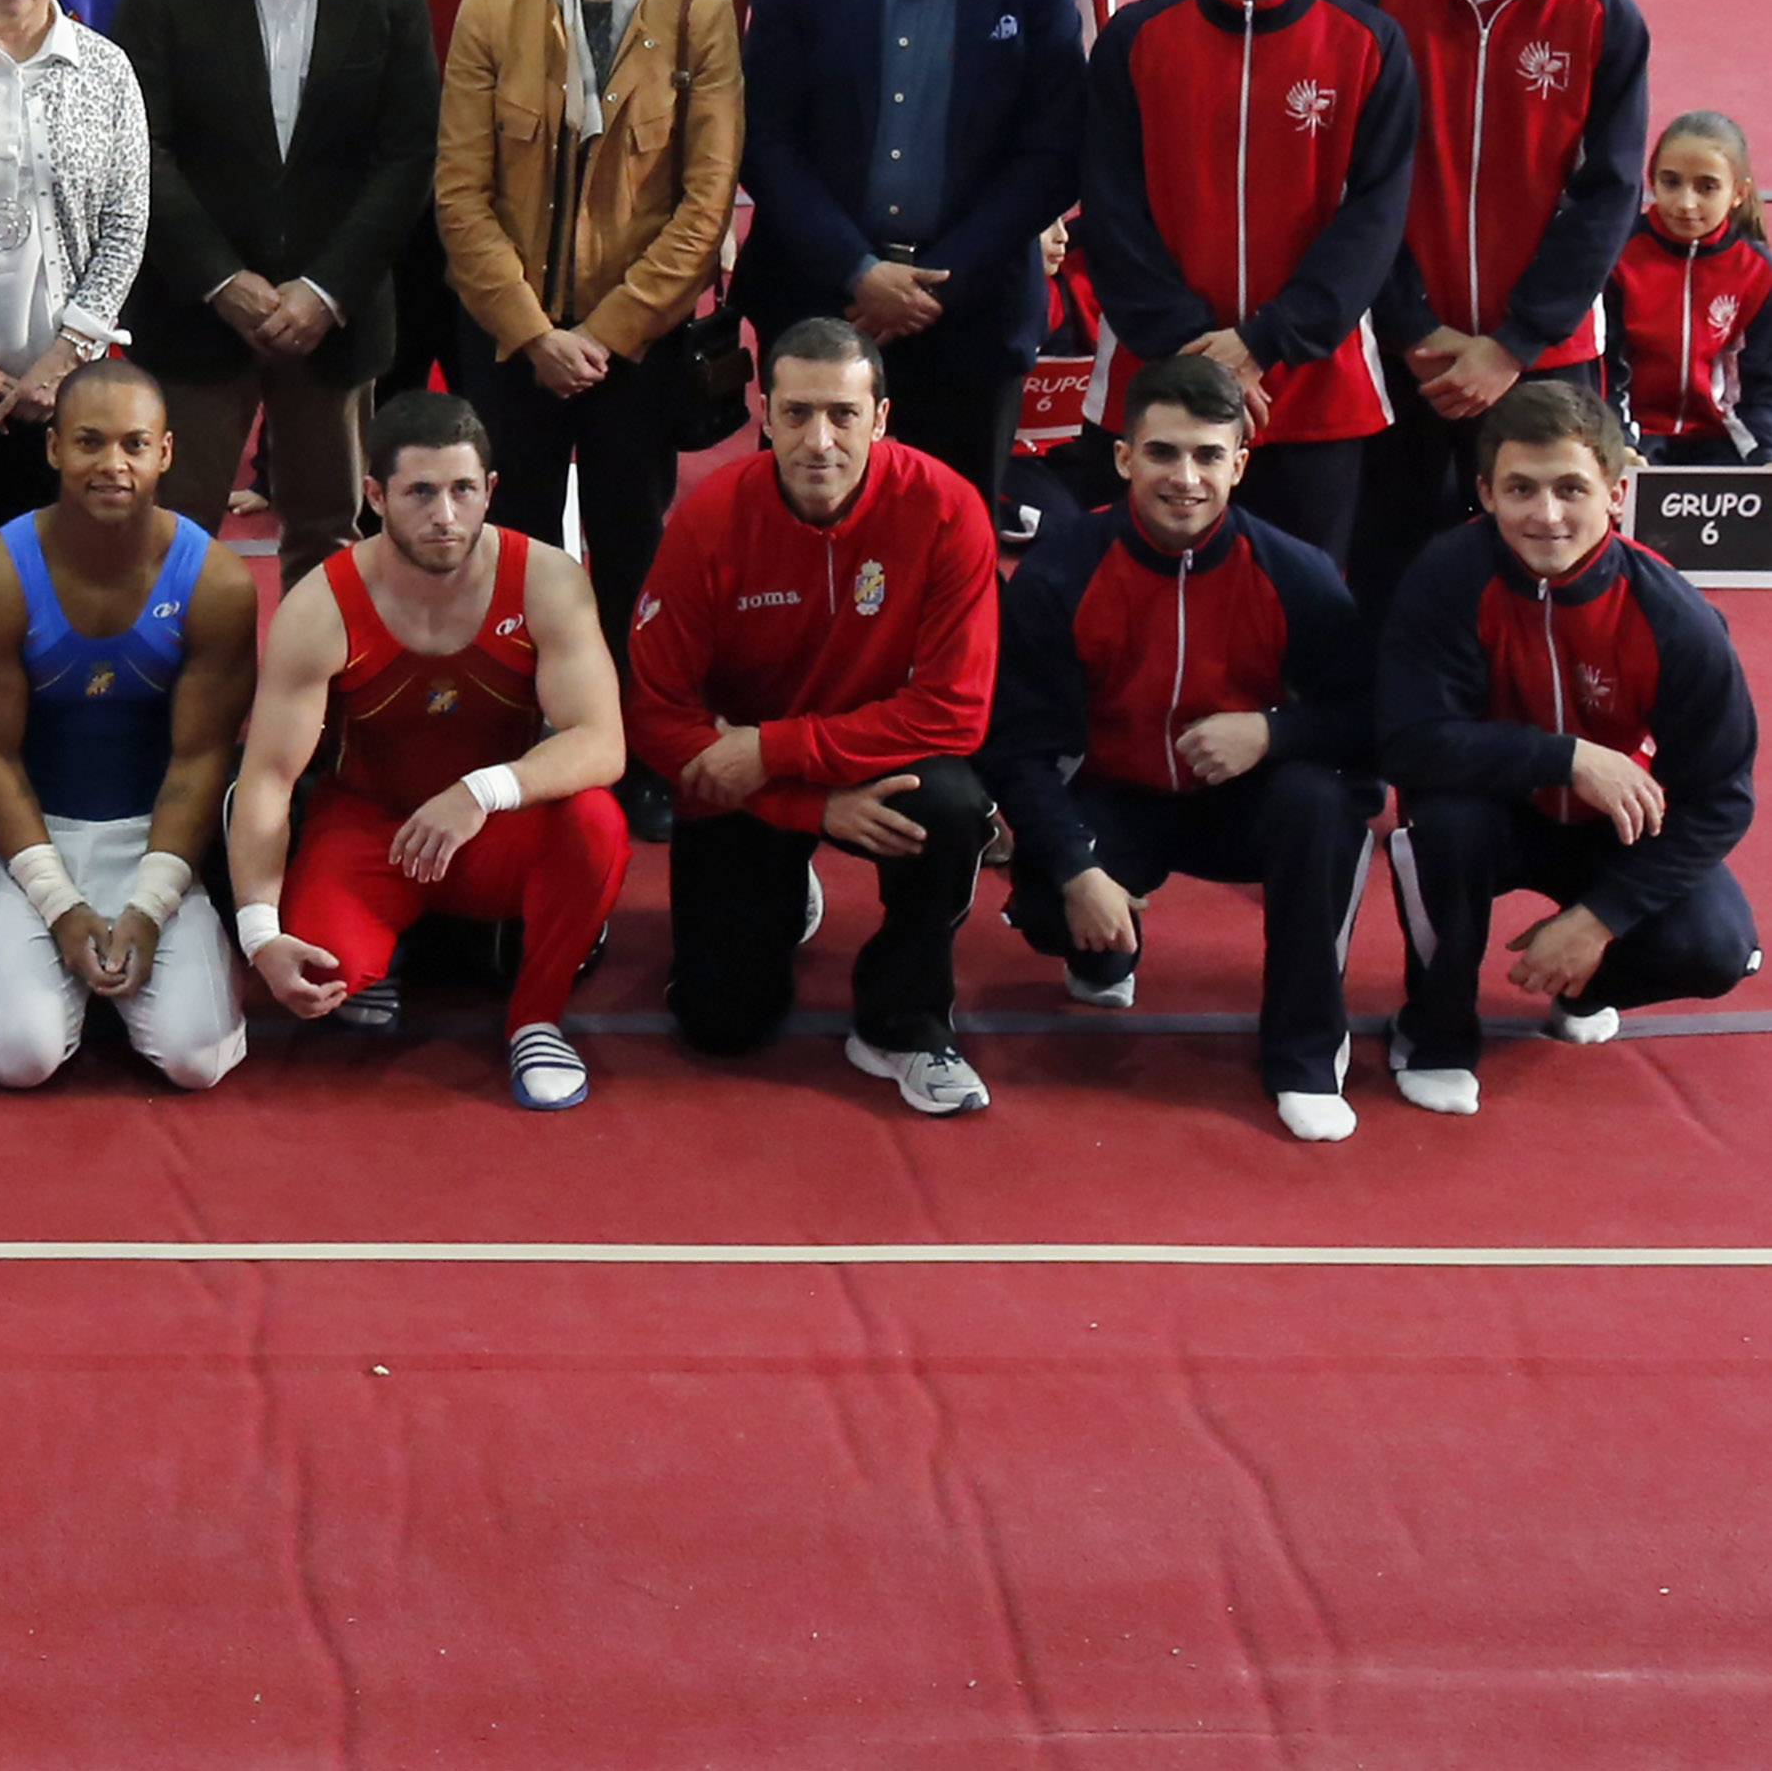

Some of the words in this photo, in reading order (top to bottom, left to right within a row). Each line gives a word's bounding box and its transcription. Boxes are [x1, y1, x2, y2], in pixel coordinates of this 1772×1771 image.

[1023, 374, 1091, 394] RUPO
[1037, 396, 1052, 412] 6
[1660, 492, 1762, 518] GRUPO
[1701, 520, 1719, 545] 6
